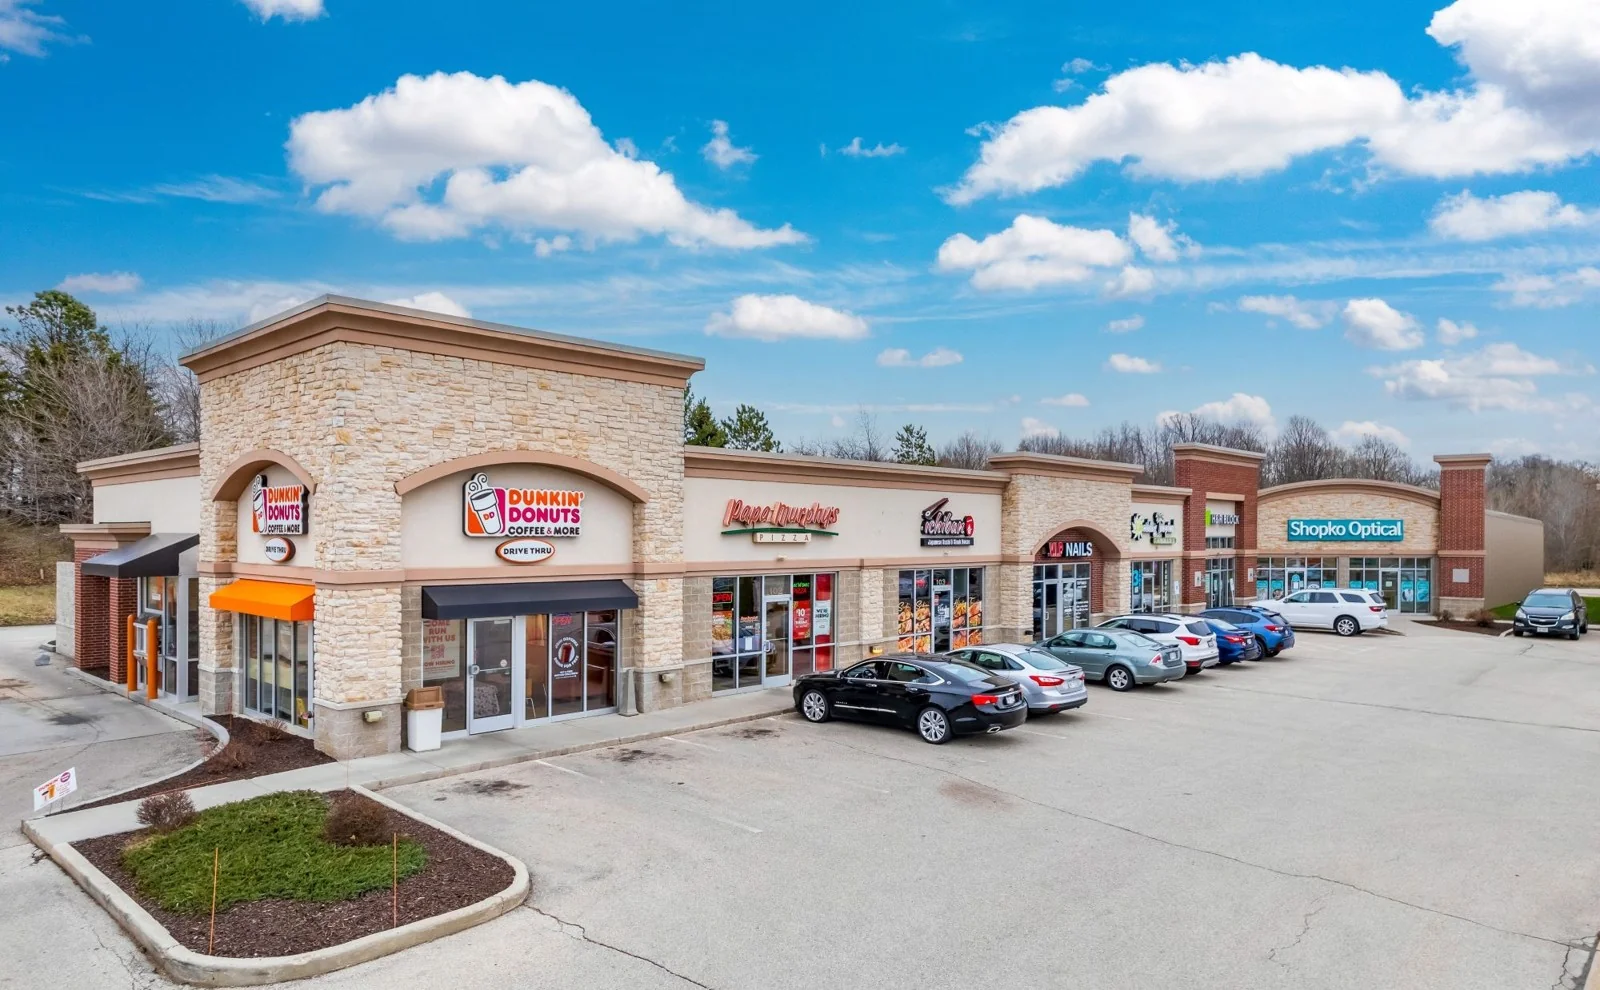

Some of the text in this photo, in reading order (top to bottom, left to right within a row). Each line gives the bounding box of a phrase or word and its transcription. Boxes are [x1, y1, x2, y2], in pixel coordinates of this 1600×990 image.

[268, 486, 302, 503] DUNKIN'
[509, 489, 584, 506] DUNKIN'
[268, 505, 300, 520] DONUTS
[509, 507, 580, 523] DONUTS
[724, 499, 839, 529] Papa Murphy's
[1224, 514, 1240, 525] BLOCK
[268, 524, 283, 533] COFFEE
[287, 524, 300, 532] MORE
[508, 527, 580, 535] COFFEE & MORE
[1290, 521, 1402, 539] Shopko Optical
[503, 547, 552, 555] DRIVE THRU
[1066, 542, 1093, 557] NAILS
